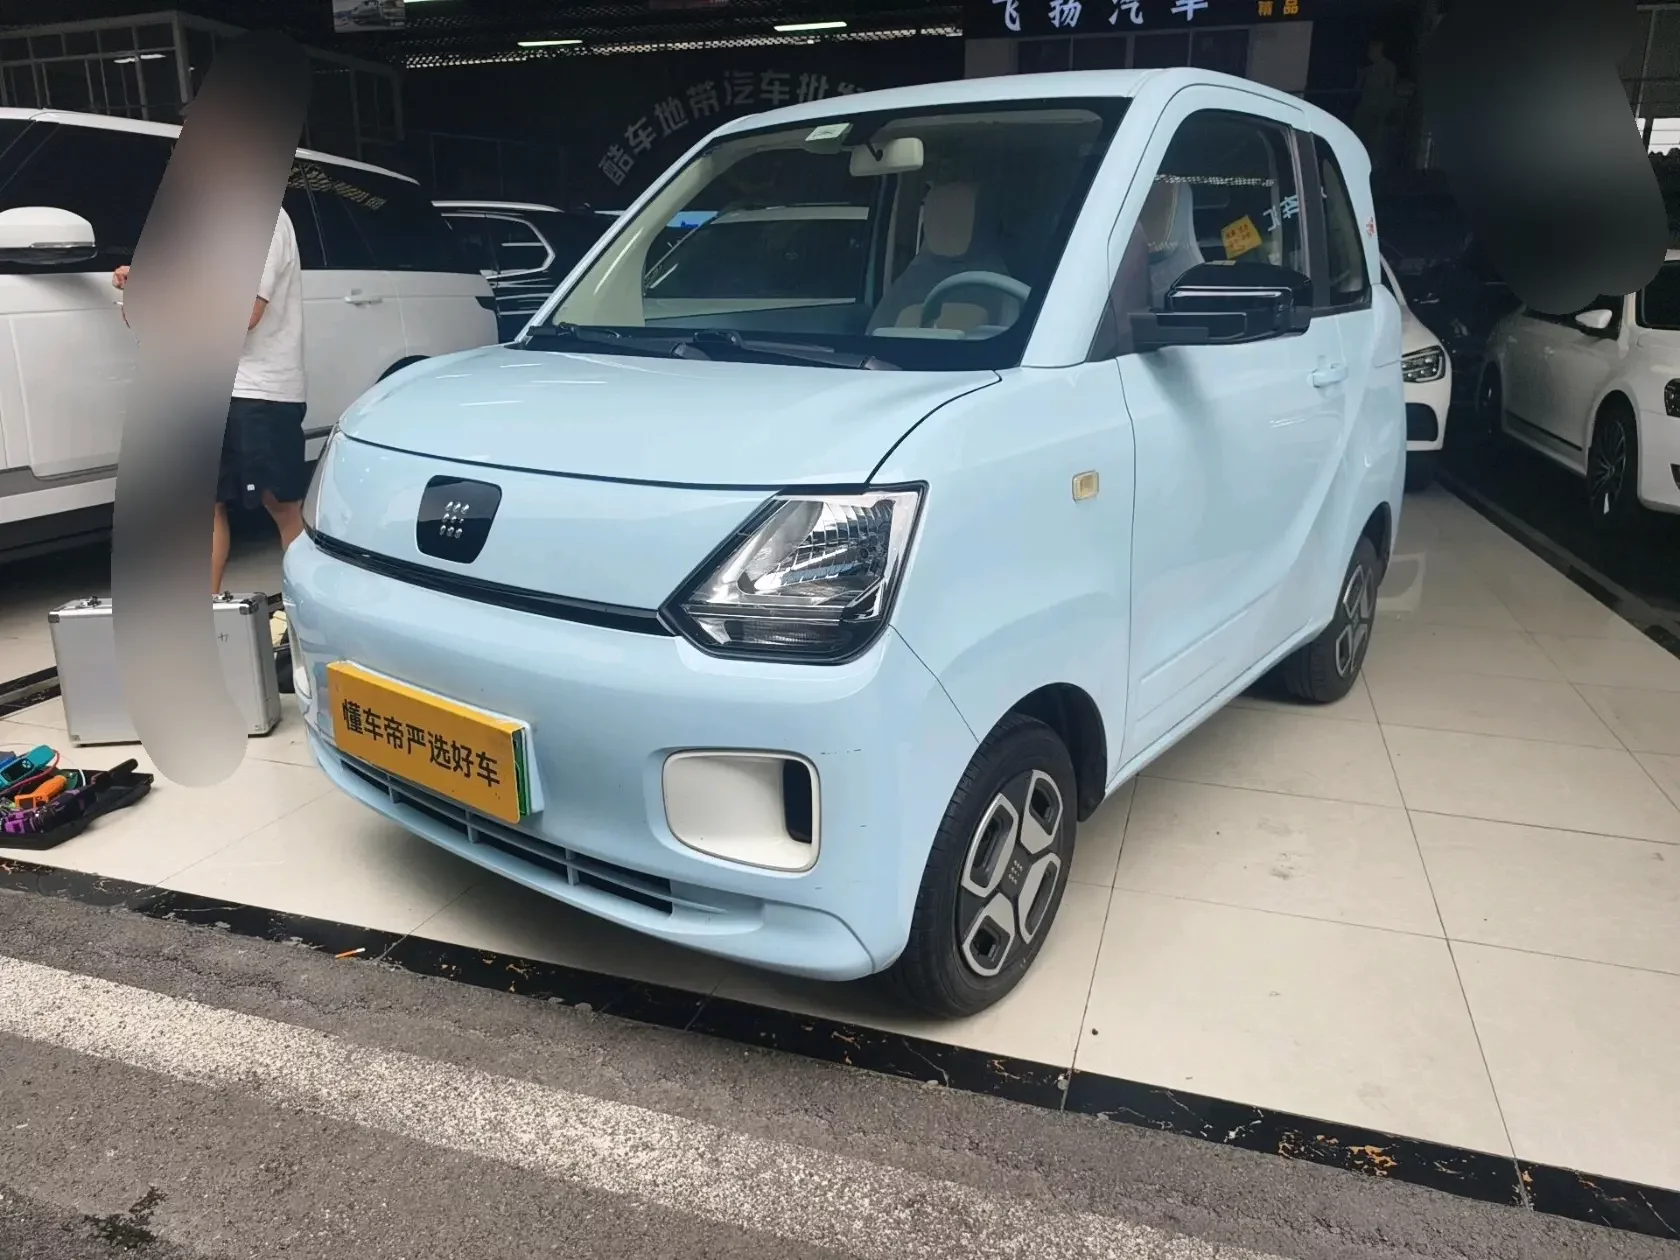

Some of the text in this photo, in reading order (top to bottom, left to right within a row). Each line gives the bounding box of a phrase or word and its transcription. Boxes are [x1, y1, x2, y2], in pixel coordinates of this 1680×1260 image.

[342, 698, 500, 787] 懂车帝严选好车
